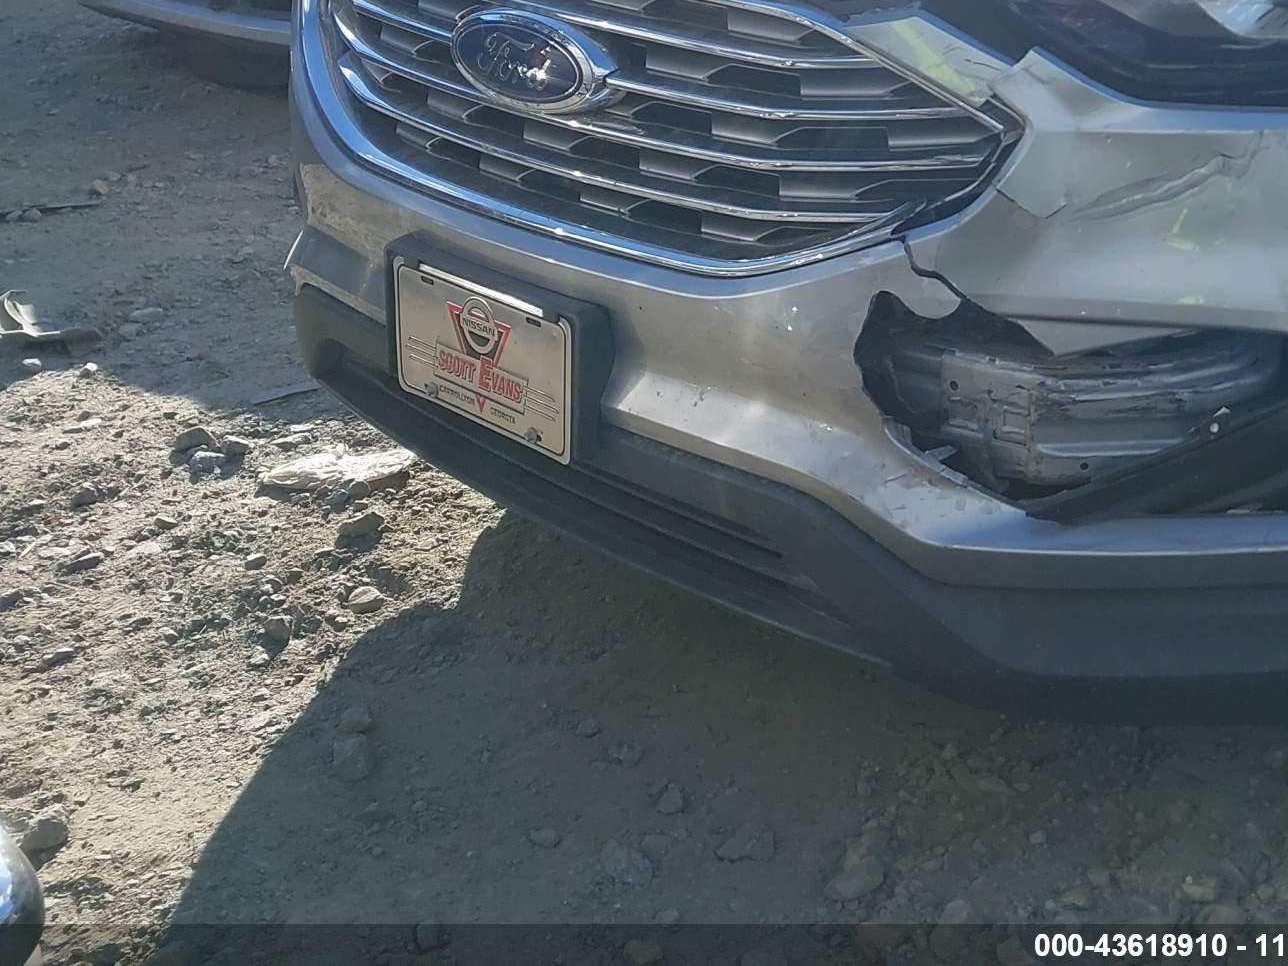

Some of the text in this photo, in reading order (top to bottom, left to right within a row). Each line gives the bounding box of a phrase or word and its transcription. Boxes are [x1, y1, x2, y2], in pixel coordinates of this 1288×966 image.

[477, 33, 550, 90] Ford
[462, 317, 496, 337] NISSAN
[438, 348, 524, 404] SCOTT EVANS
